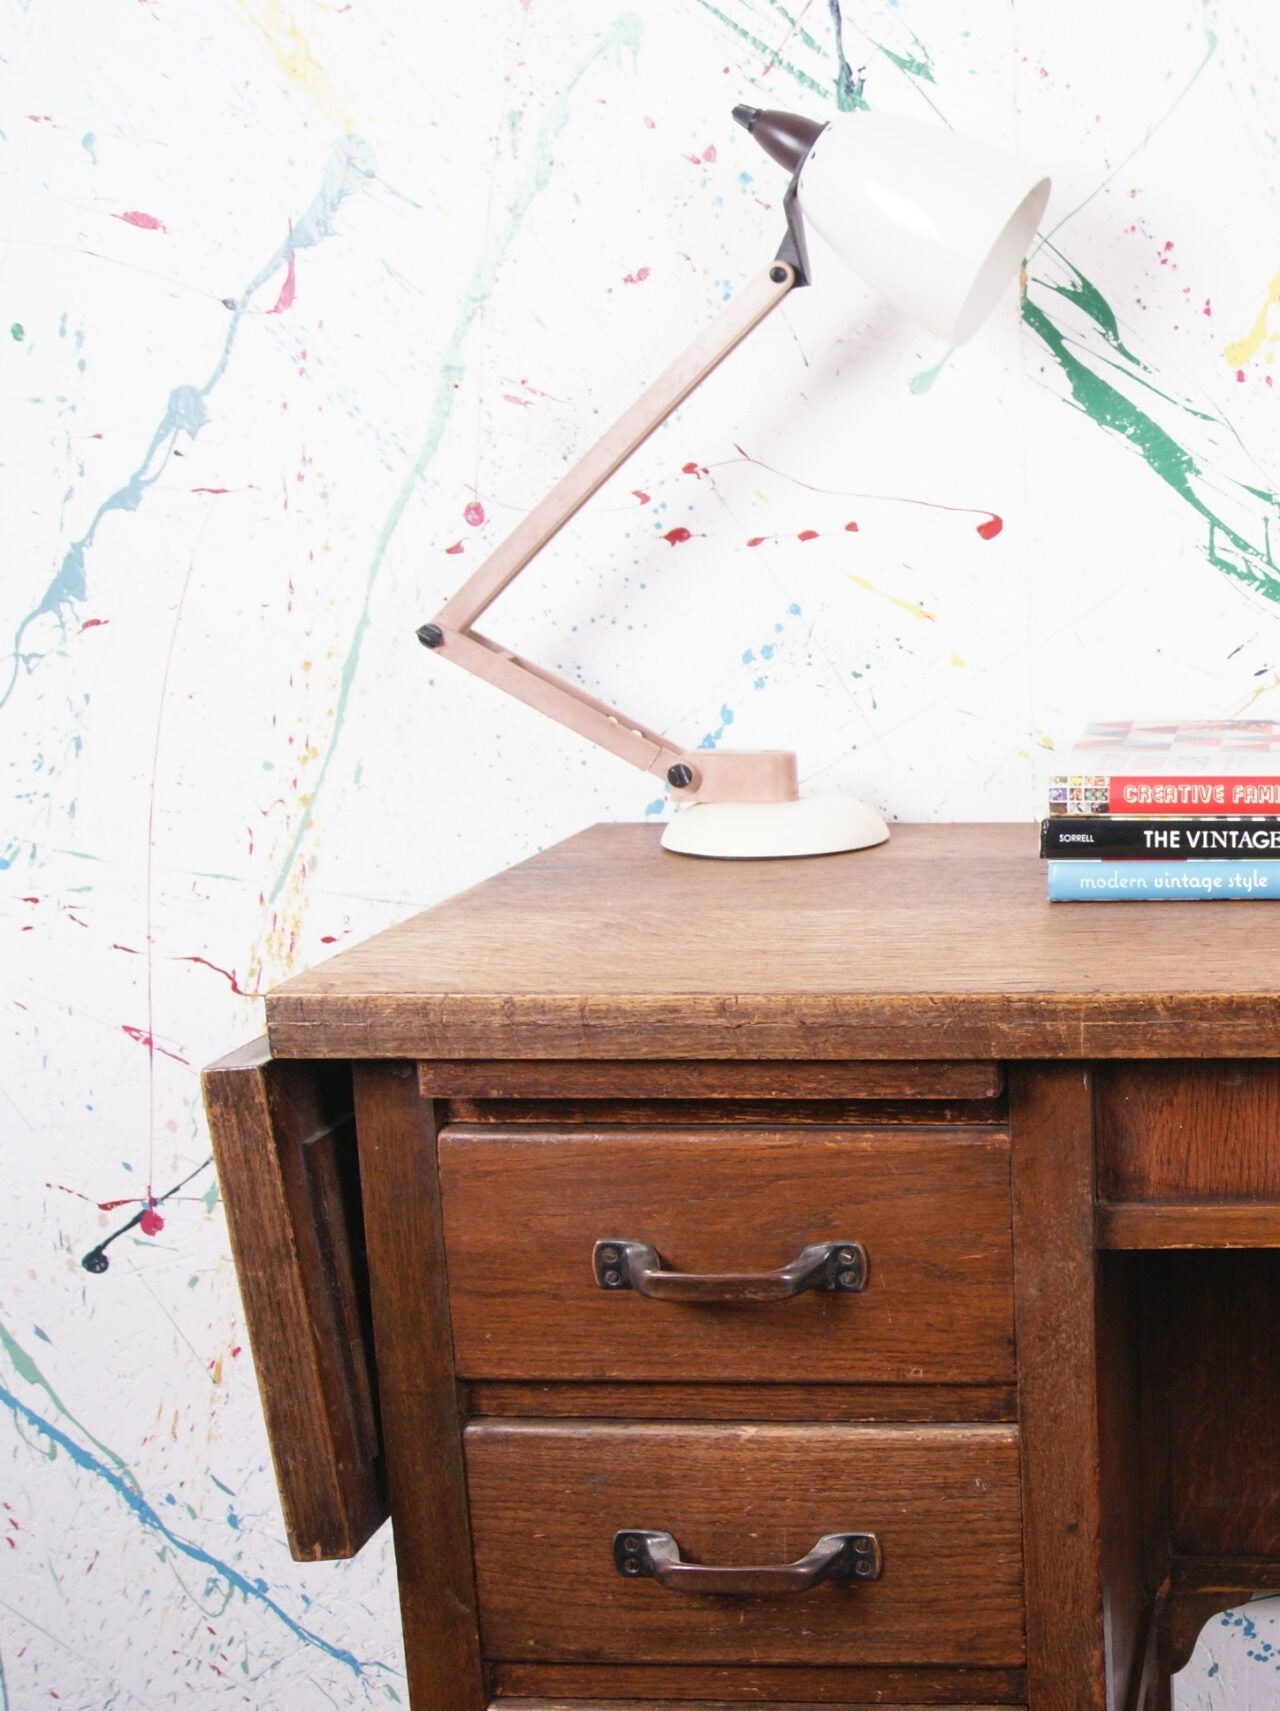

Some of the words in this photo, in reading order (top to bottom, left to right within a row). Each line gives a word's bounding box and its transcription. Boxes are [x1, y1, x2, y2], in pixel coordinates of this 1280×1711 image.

[1124, 784, 1225, 803] CREATIVE
[1058, 833, 1095, 843] SORRELL
[1143, 830, 1181, 848] THE
[1080, 871, 1147, 888] modern
[1154, 872, 1222, 893] vintage
[1228, 869, 1269, 892] style
